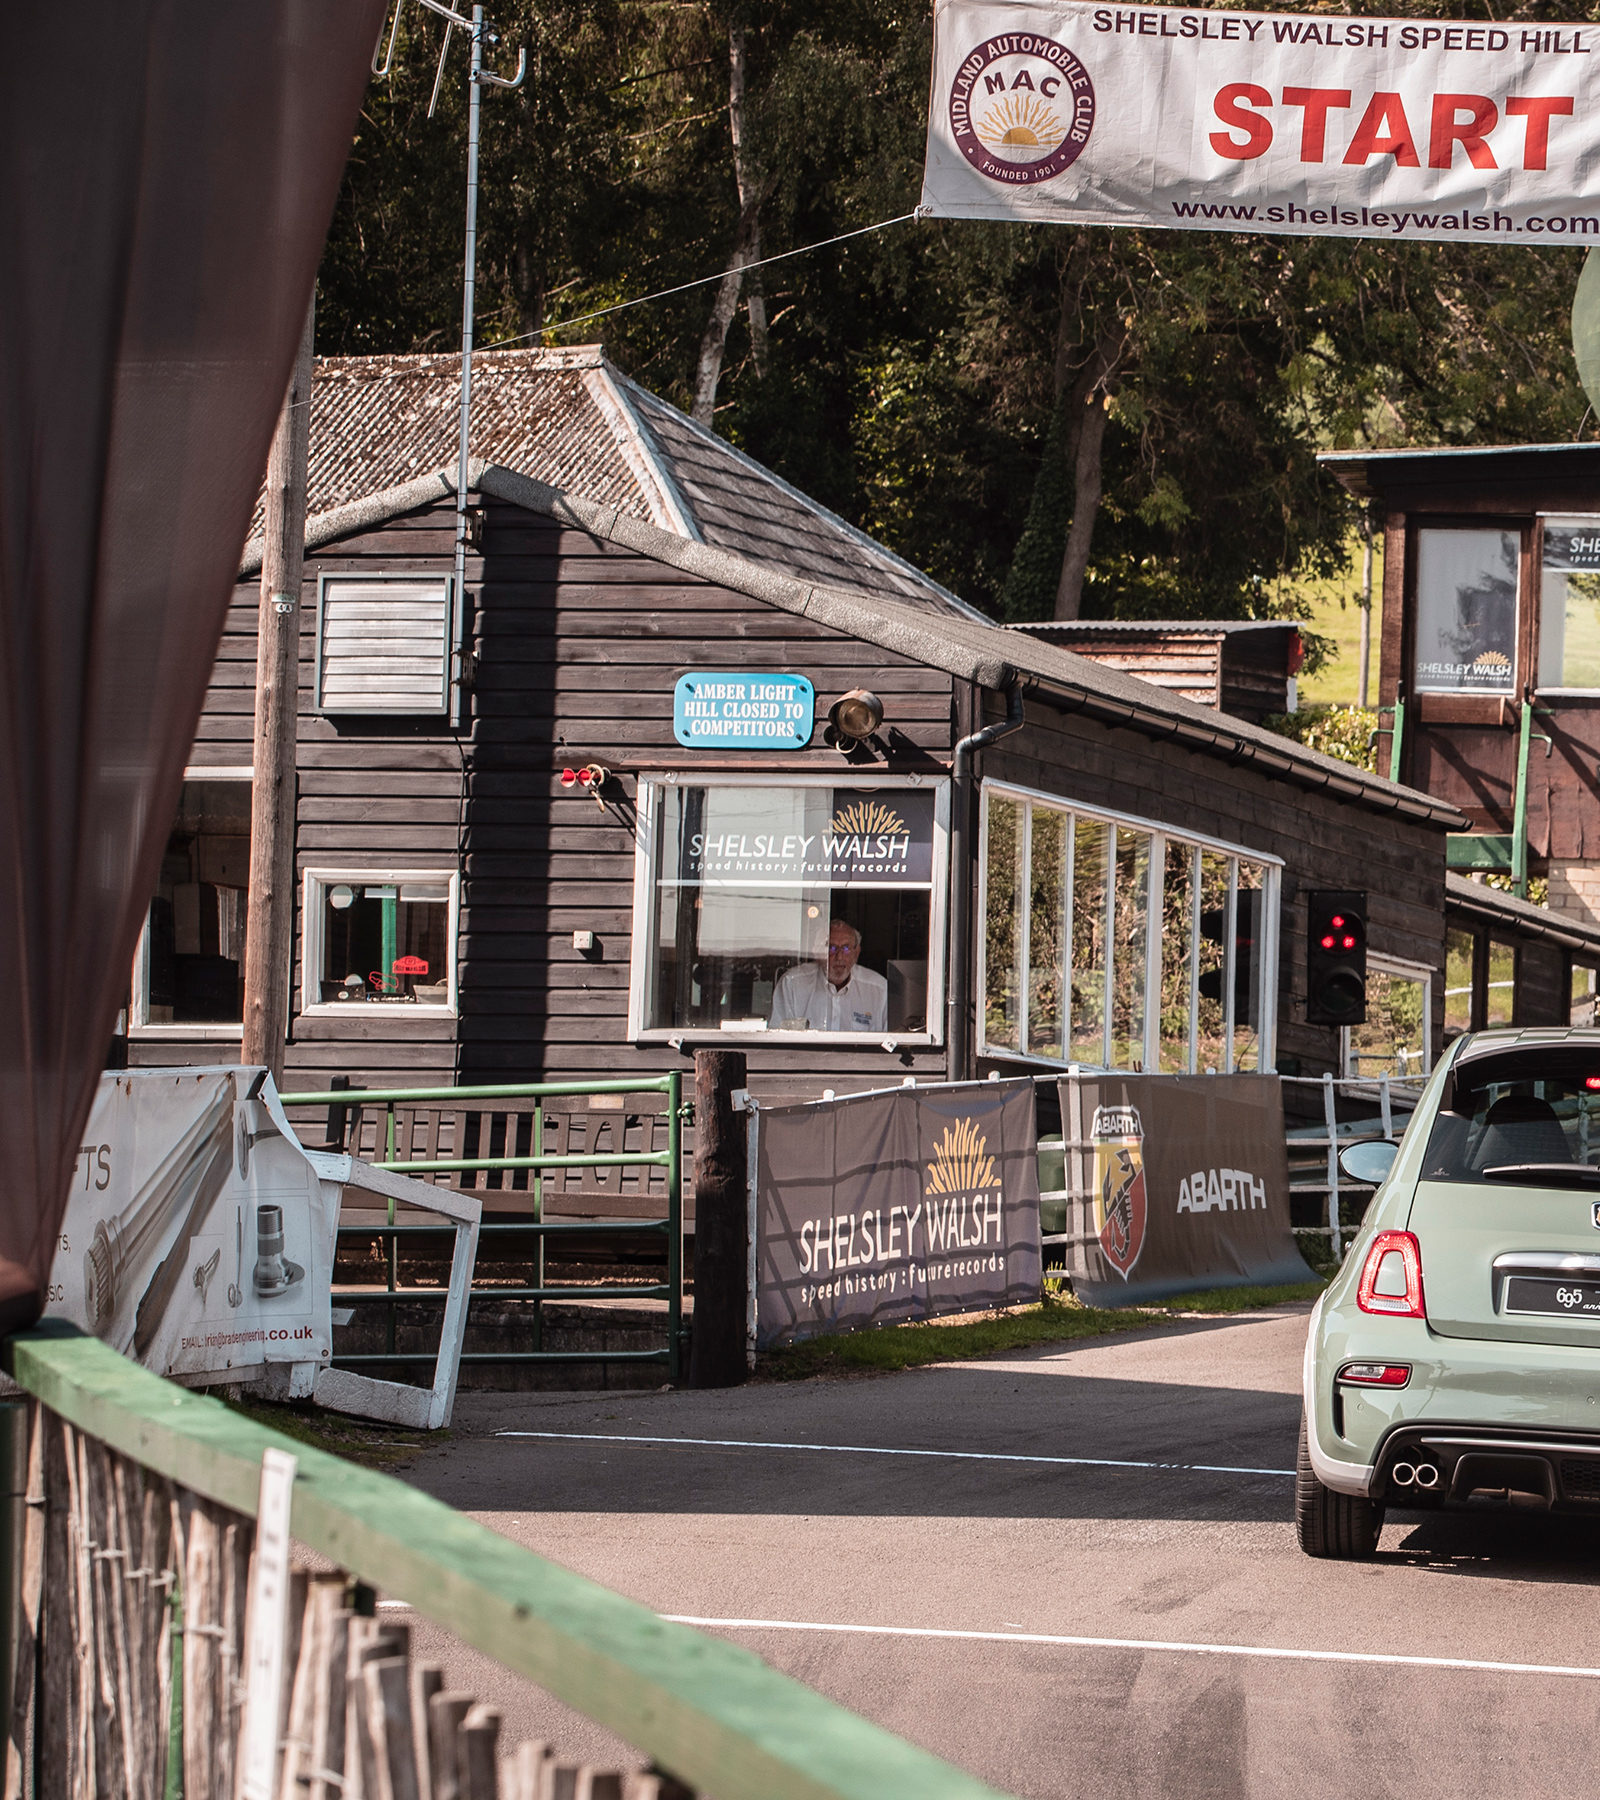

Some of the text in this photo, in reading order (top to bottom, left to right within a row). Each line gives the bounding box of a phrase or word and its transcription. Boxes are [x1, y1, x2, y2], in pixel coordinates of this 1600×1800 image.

[1093, 9, 1264, 41] SHELSLEY
[1272, 21, 1388, 48] WALSH
[1399, 26, 1509, 51] SPEED
[1520, 30, 1590, 54] HILL
[952, 35, 1092, 143] MIDLAND AUTOMOBILE CLUB
[983, 70, 1061, 98] MAC
[1209, 82, 1574, 171] START
[982, 161, 1056, 180] FOUNDED 1901
[1172, 202, 1600, 234] www.shelsleywalsh.com
[1569, 554, 1599, 563] speed
[1416, 662, 1512, 676] SHELSLEY WALSH
[693, 683, 796, 701] AMBER LIGHT
[684, 701, 804, 719] HILL CLOSED TO
[691, 719, 795, 737] COMPETITORS
[689, 834, 910, 859] SHELSLEY WALSH
[689, 861, 731, 873] speed
[735, 861, 788, 874] history
[800, 861, 847, 874] future
[851, 862, 908, 873] records
[1095, 1114, 1138, 1134] ABARTH
[1176, 1168, 1267, 1214] ABARTH
[799, 1192, 1002, 1274] SHELSLEY WALSH
[801, 1275, 841, 1307] speed
[845, 1270, 897, 1293] history
[909, 1263, 951, 1289] future
[953, 1252, 1004, 1276] records
